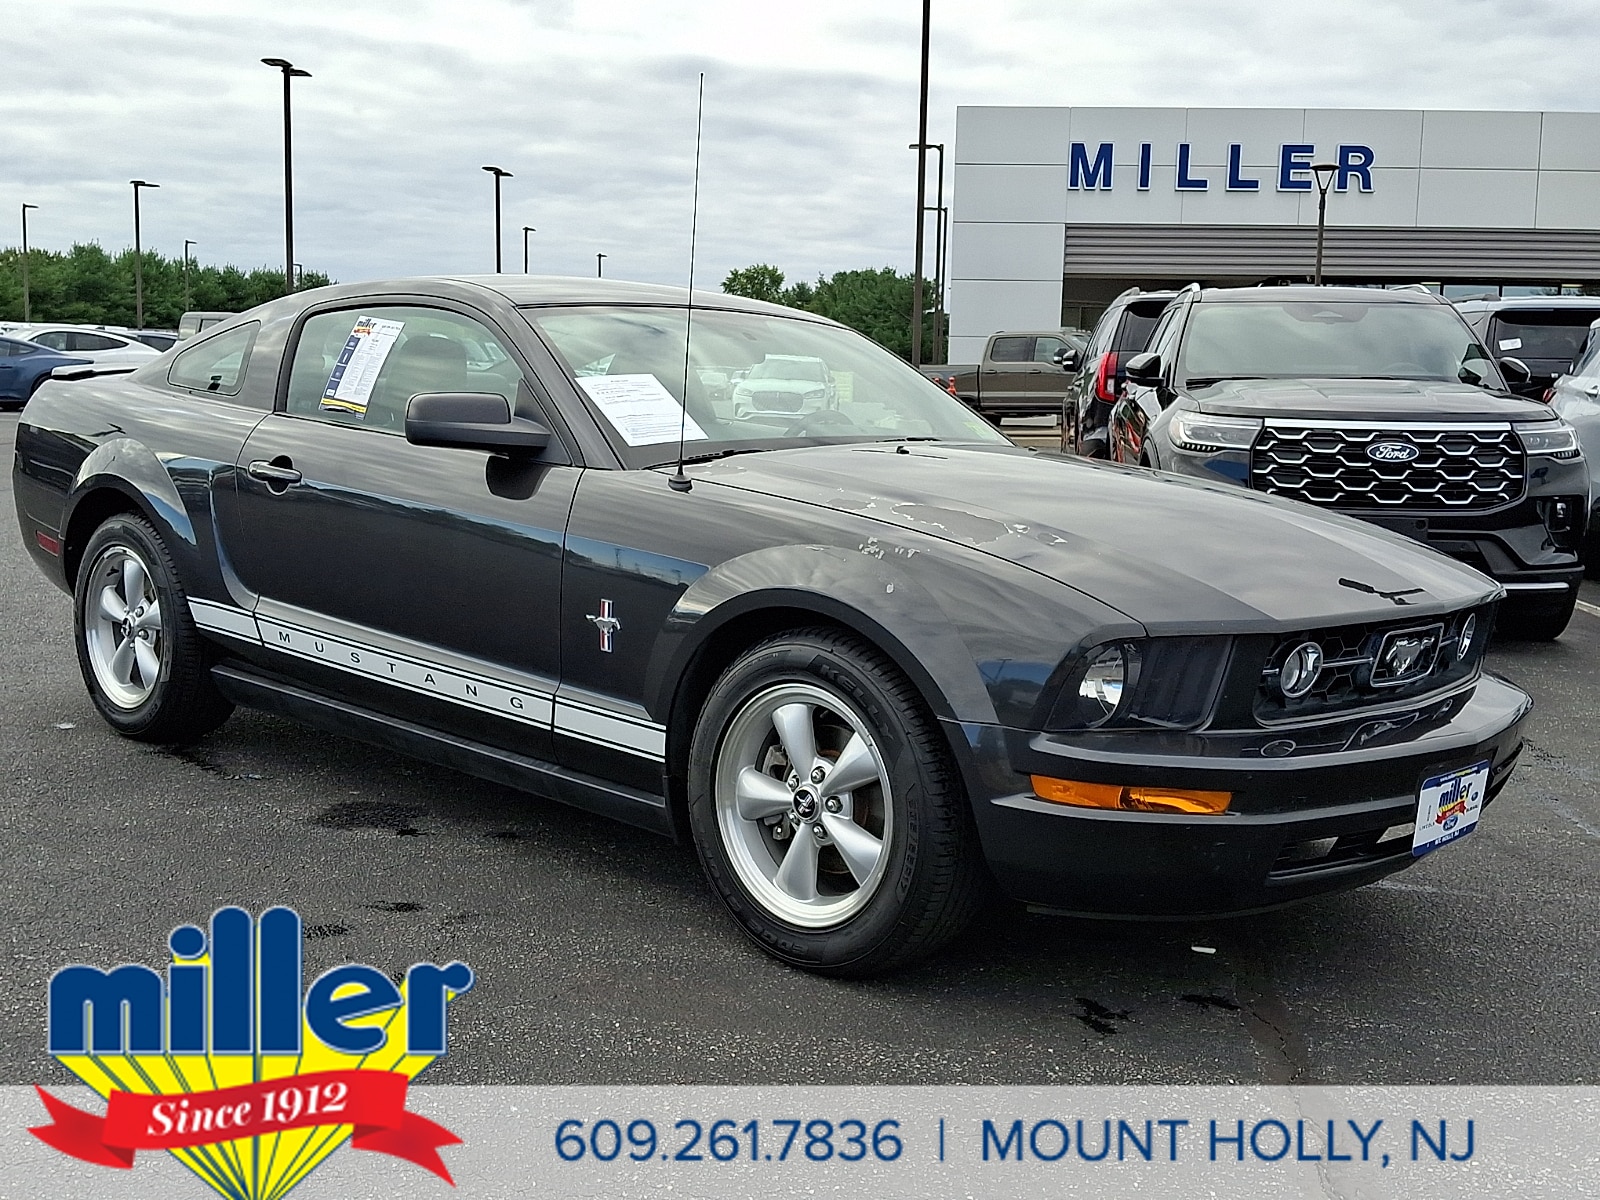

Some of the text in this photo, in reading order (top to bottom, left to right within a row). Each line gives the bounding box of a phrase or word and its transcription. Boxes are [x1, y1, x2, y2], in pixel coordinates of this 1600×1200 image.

[1068, 142, 1375, 191] MILLER
[1375, 446, 1410, 459] Ford
[278, 630, 525, 711] MUSTANG
[820, 664, 894, 741] KELLY
[1438, 777, 1473, 809] miller
